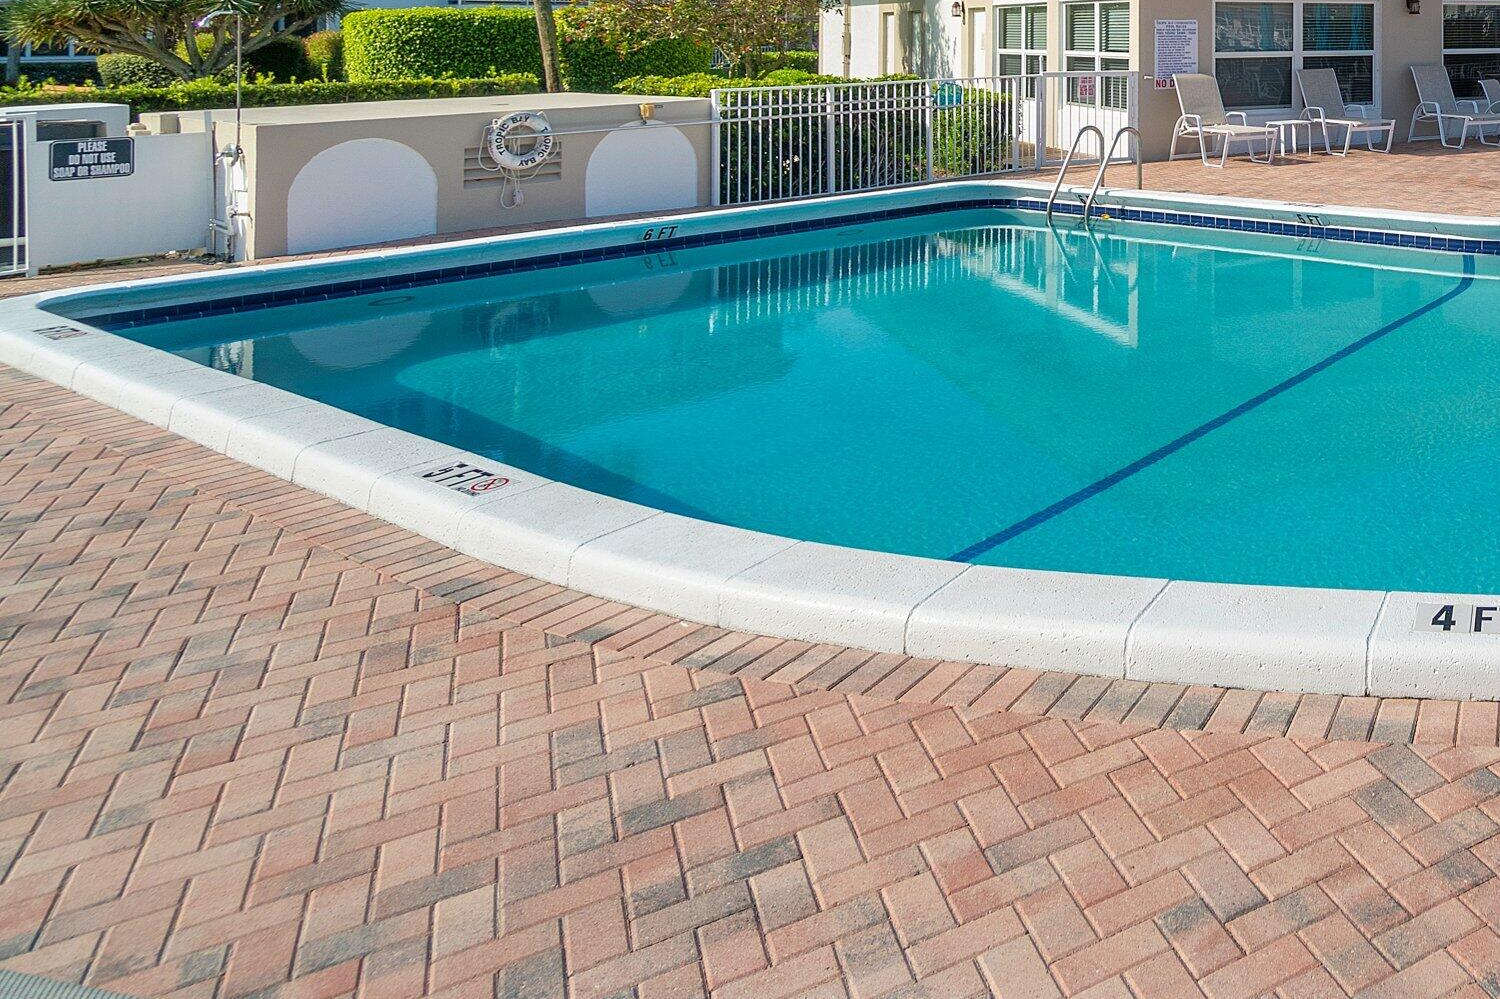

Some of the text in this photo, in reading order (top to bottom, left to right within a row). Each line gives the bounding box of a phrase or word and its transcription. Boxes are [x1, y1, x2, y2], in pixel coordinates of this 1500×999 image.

[1155, 79, 1167, 88] NO
[77, 140, 108, 153] PLEASE
[495, 123, 509, 156] TROPIC
[518, 126, 551, 167] TOPIC BAY
[68, 152, 117, 166] DO NOT USE
[53, 163, 130, 178] SOAP OR SHAMPOO
[1296, 213, 1322, 227] 5 FT
[643, 225, 679, 241] 6 FT
[434, 468, 496, 487] FT
[1431, 604, 1456, 632] 4
